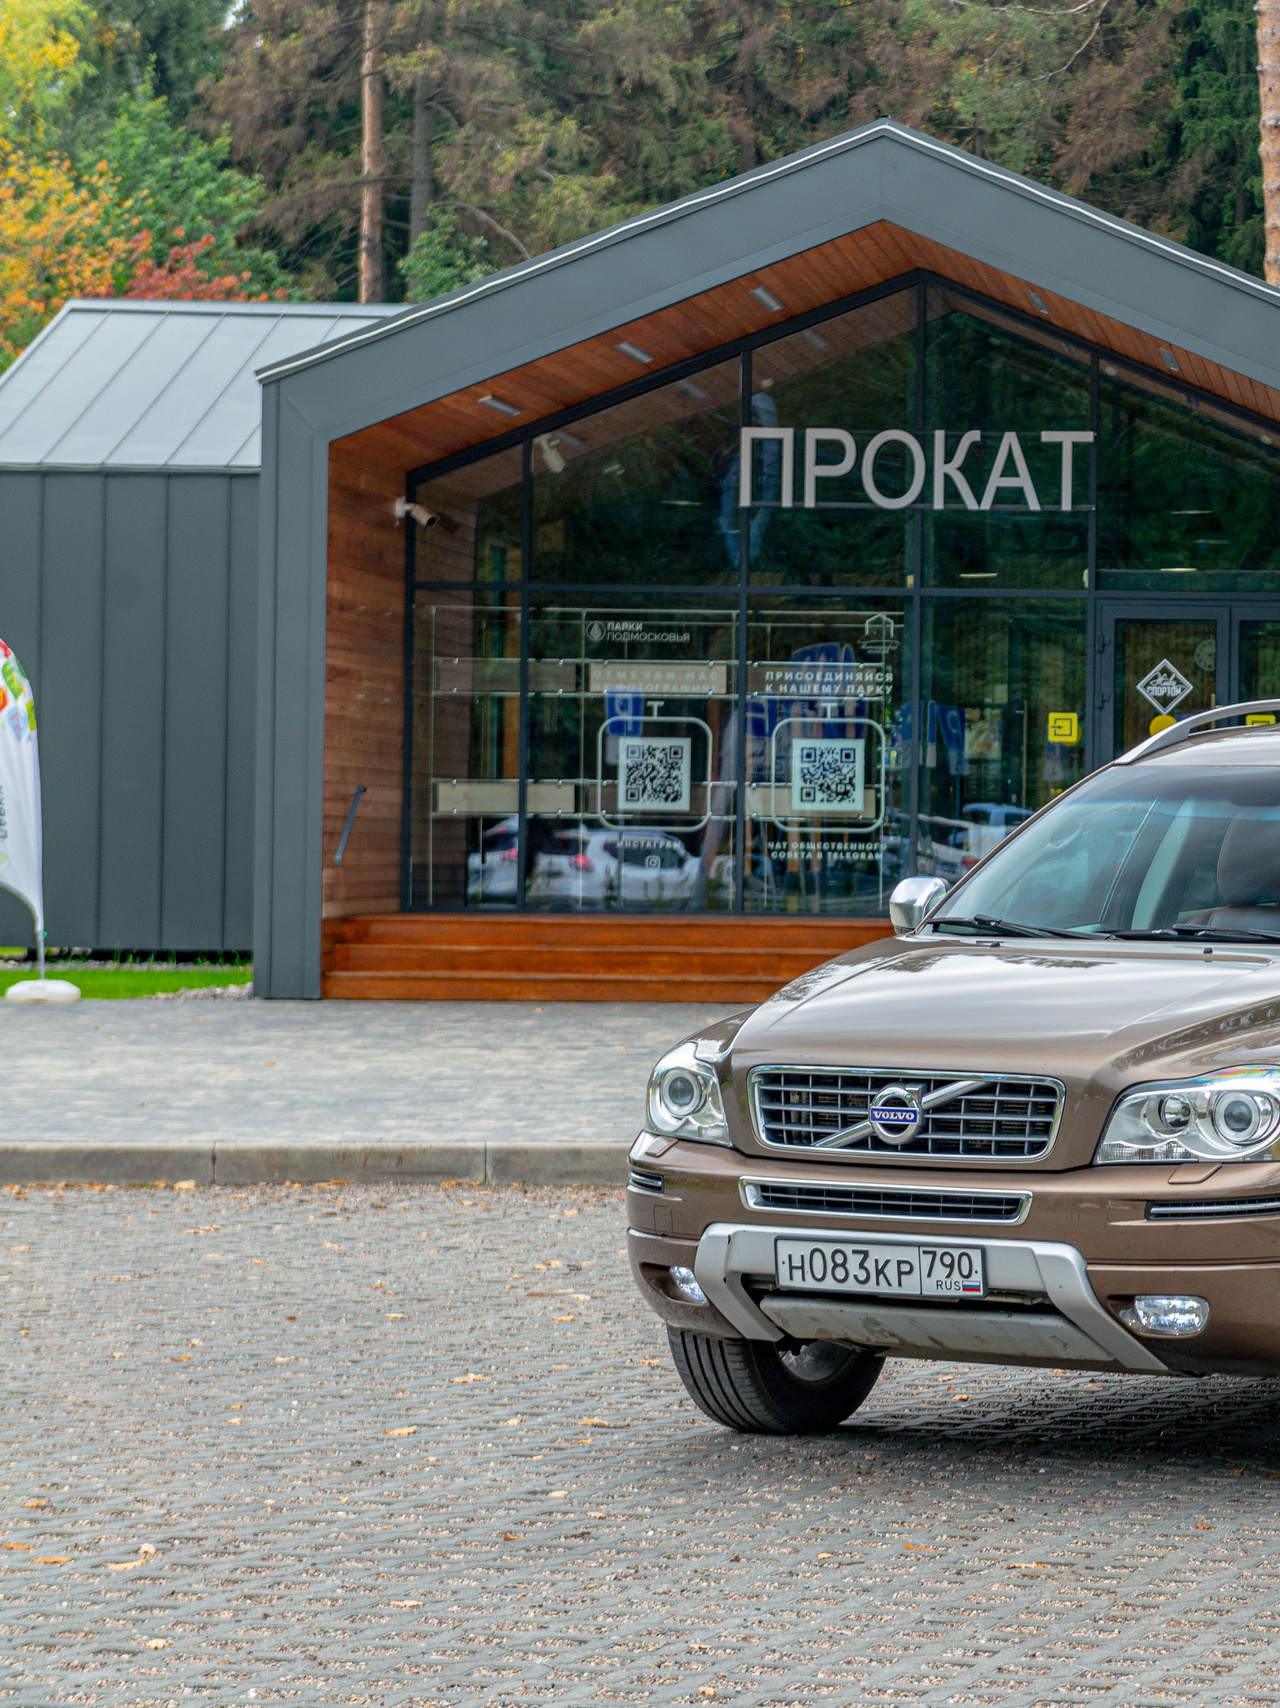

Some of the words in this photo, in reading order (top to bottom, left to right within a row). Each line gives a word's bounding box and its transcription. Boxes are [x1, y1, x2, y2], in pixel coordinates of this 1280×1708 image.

[739, 427, 1095, 511] ПРОКАТ
[607, 621, 643, 631] ПАРКИ
[607, 631, 690, 642] ПОДМОСКОВЬЯ
[593, 668, 676, 680] ОТМЕЧАЙ
[685, 671, 719, 680] НАС
[765, 669, 893, 682] ПРИСОЕДИНЯЙСЯ
[765, 684, 774, 692] К
[780, 684, 841, 694] НАШЕМУ
[846, 684, 893, 694] ПАРКУ
[617, 840, 681, 849] ИНСТАГРАМ
[768, 842, 788, 850] ЧАТ
[792, 842, 888, 850] ОБЩЕСТВЕННОГО
[771, 851, 813, 859] СОВЕТА
[827, 852, 883, 860] TELEGRAM
[873, 1110, 915, 1121] VOLVO
[922, 1250, 974, 1278] 790
[936, 1280, 961, 1291] RUS
